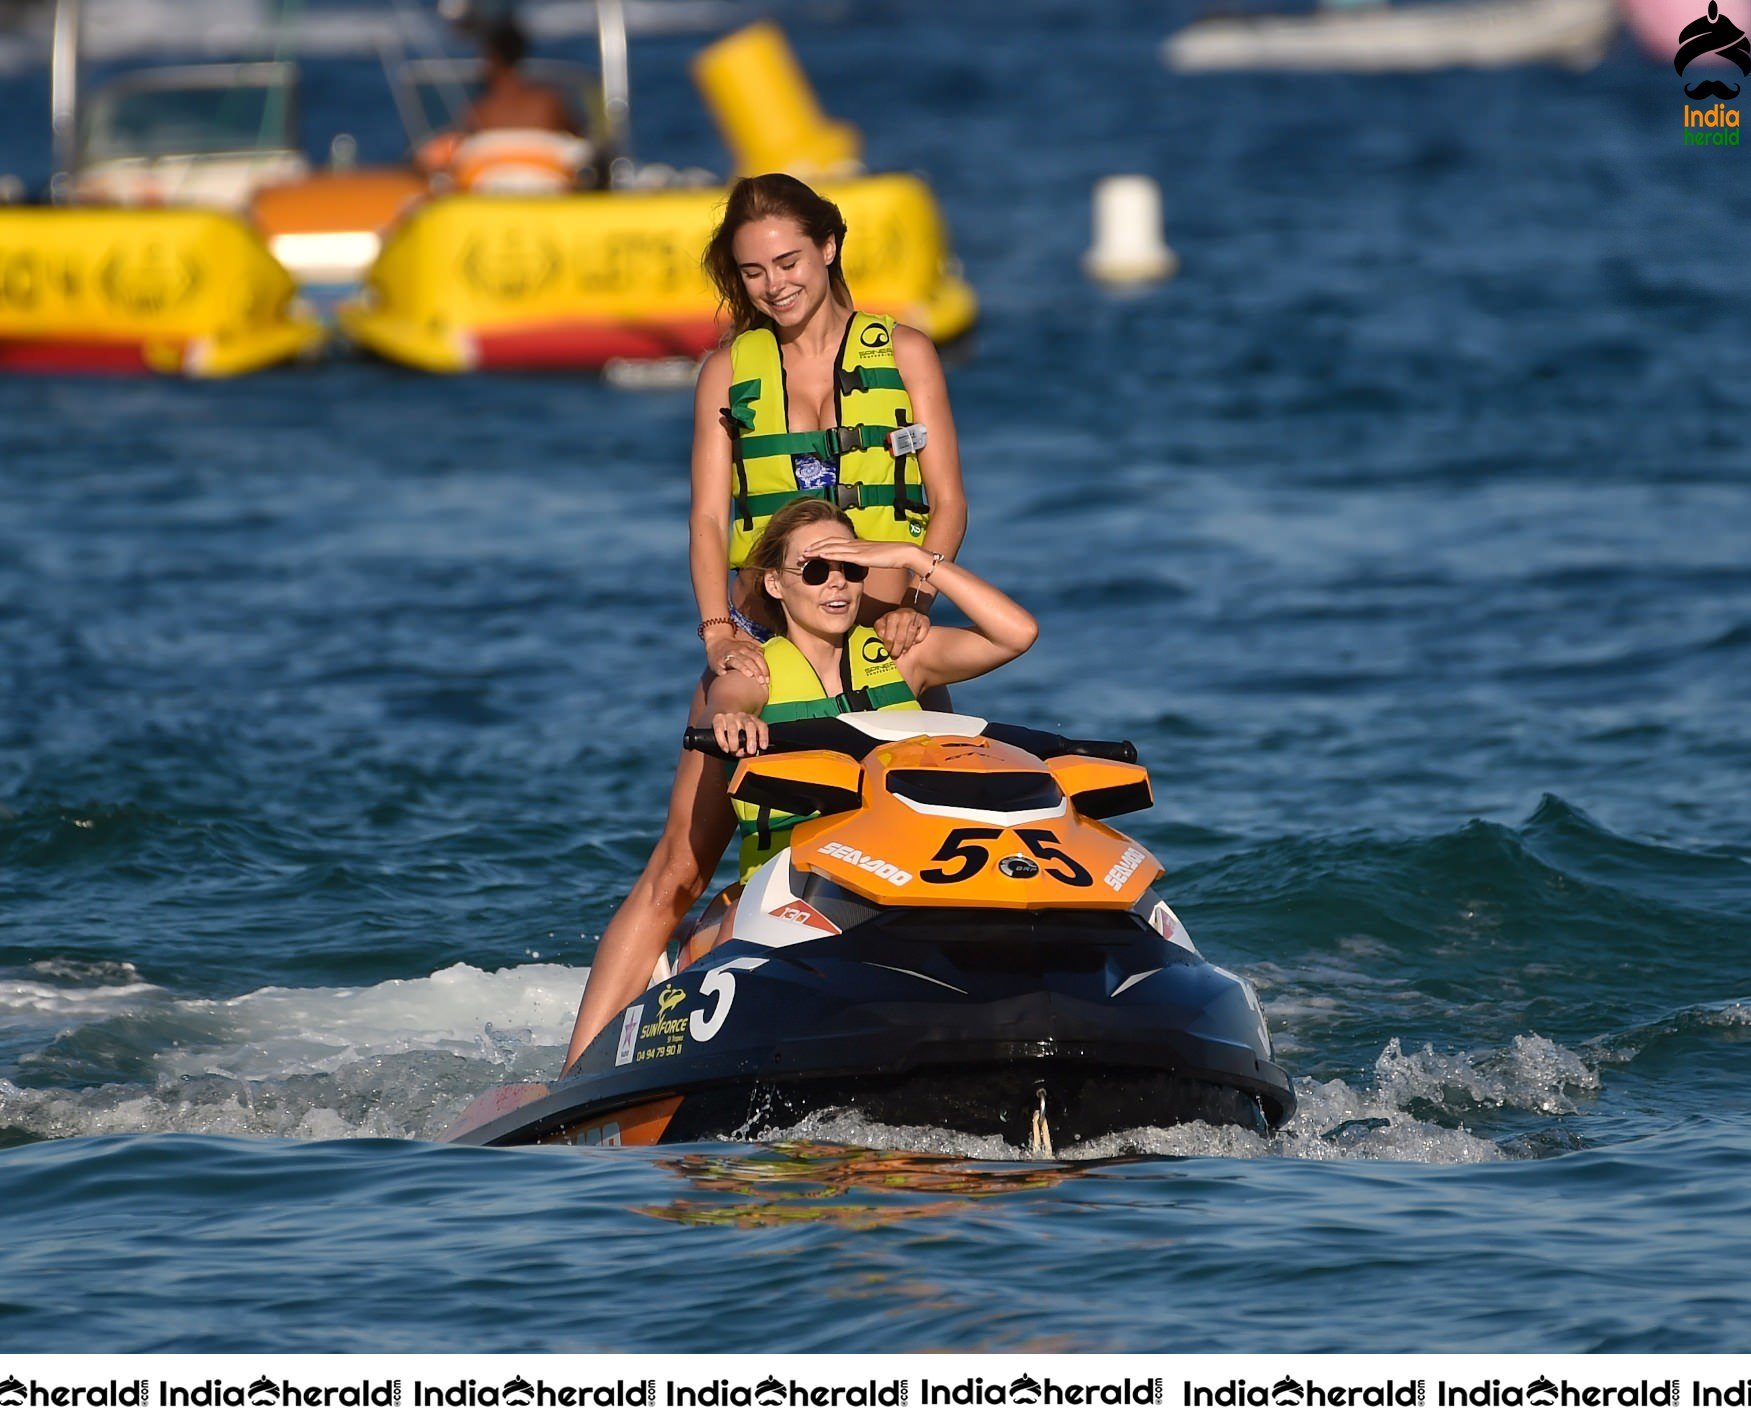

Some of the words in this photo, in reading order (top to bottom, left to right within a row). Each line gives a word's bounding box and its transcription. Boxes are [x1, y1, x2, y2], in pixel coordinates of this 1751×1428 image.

[689, 957, 770, 1042] 5
[636, 1050, 646, 1062] 04
[646, 1048, 656, 1060] 94
[656, 1046, 666, 1057] 79
